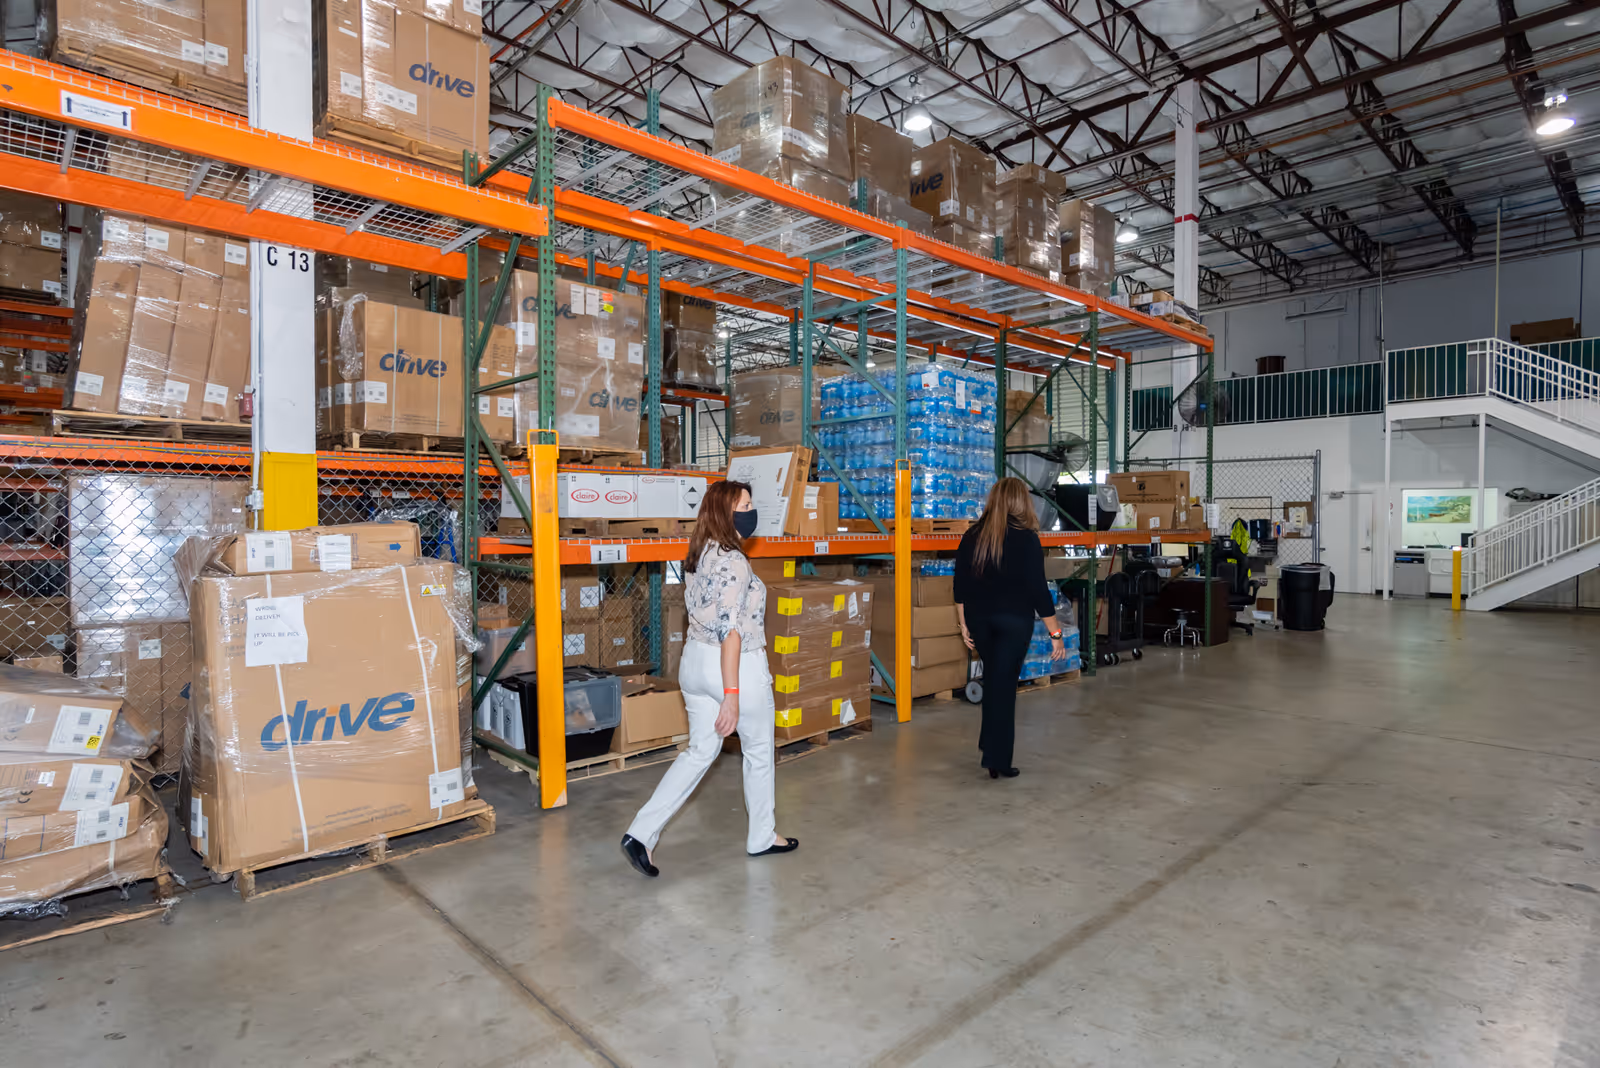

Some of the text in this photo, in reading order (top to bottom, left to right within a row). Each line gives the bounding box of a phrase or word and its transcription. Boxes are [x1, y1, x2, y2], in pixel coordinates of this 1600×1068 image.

[408, 61, 475, 98] drive
[267, 246, 309, 272] C 13
[379, 348, 447, 378] drive
[575, 491, 596, 500] claire
[609, 492, 628, 501] claire
[261, 692, 415, 752] drive
